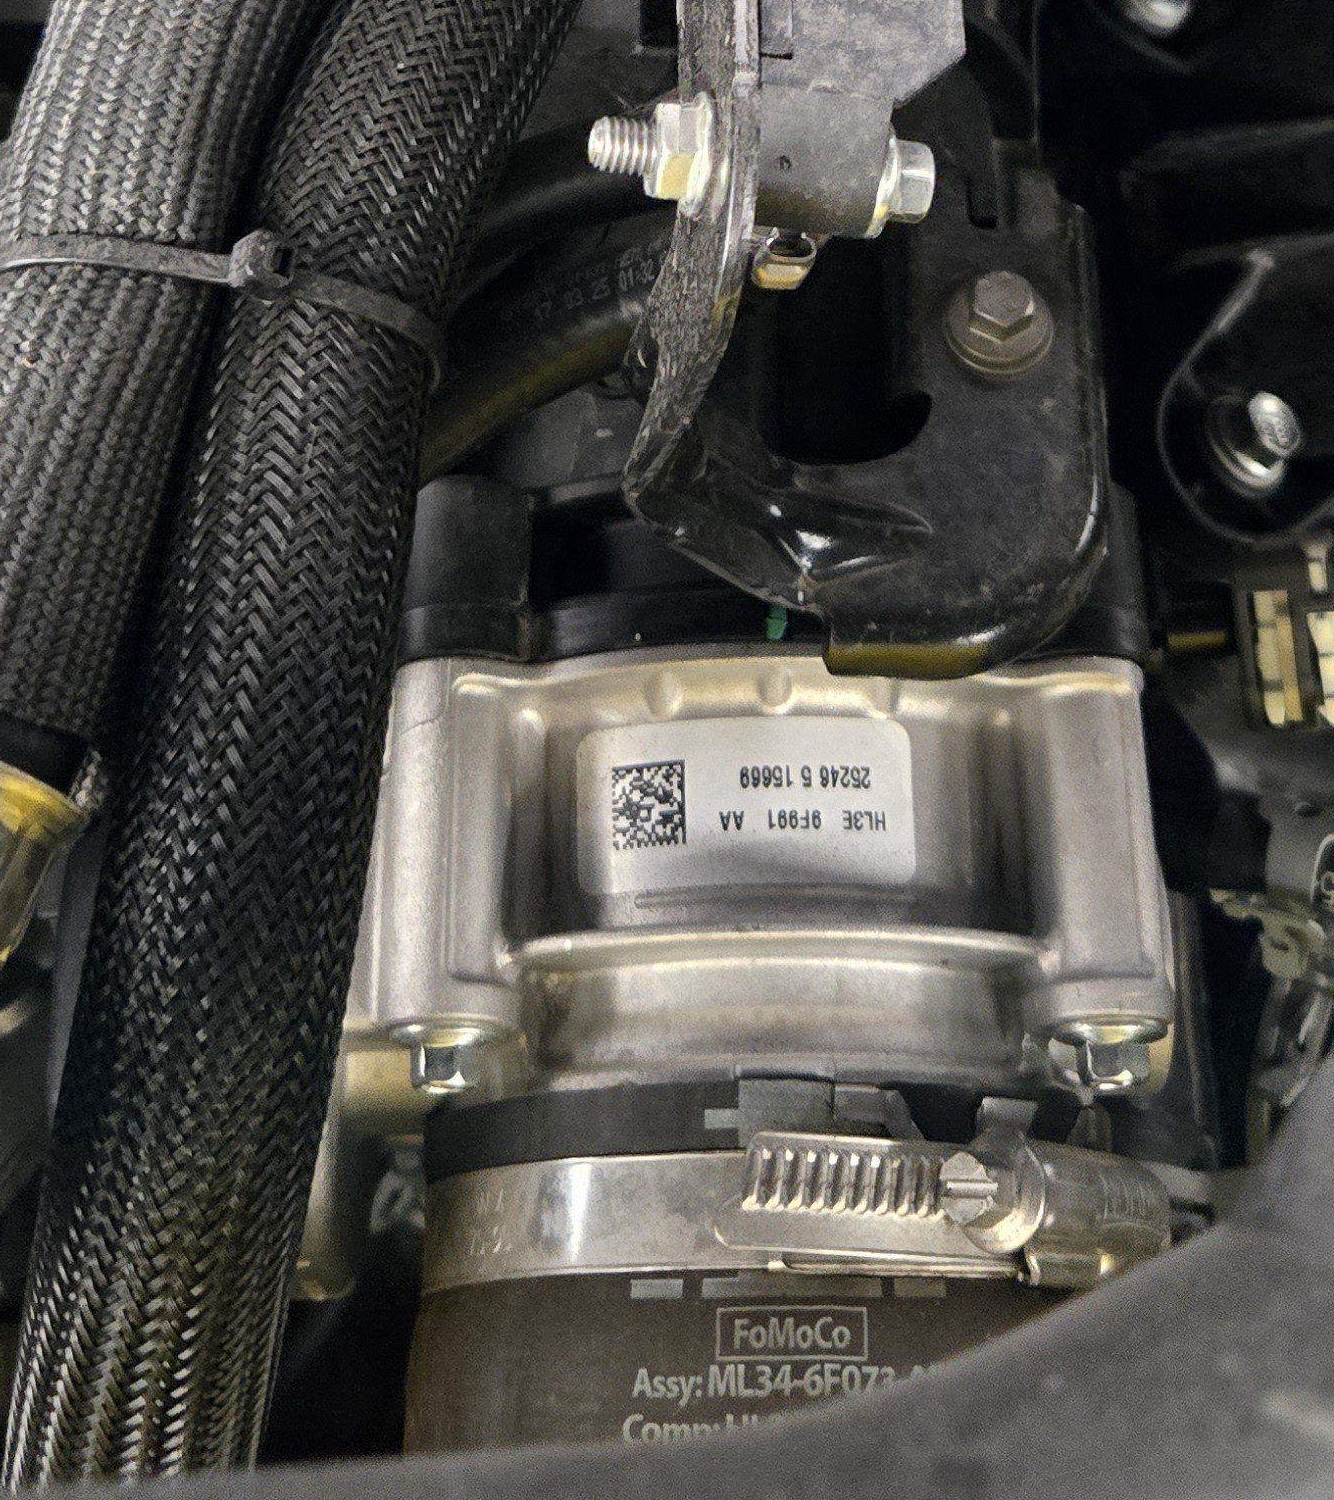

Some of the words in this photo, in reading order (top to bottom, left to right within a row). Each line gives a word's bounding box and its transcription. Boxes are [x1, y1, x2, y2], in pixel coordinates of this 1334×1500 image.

[800, 764, 812, 788] 5
[819, 765, 871, 789] 25246
[718, 809, 745, 831] AA
[767, 808, 822, 830] 9F991
[842, 809, 887, 831] HL3E
[732, 1316, 852, 1350] FoMoCo
[632, 1366, 703, 1407] Assy:
